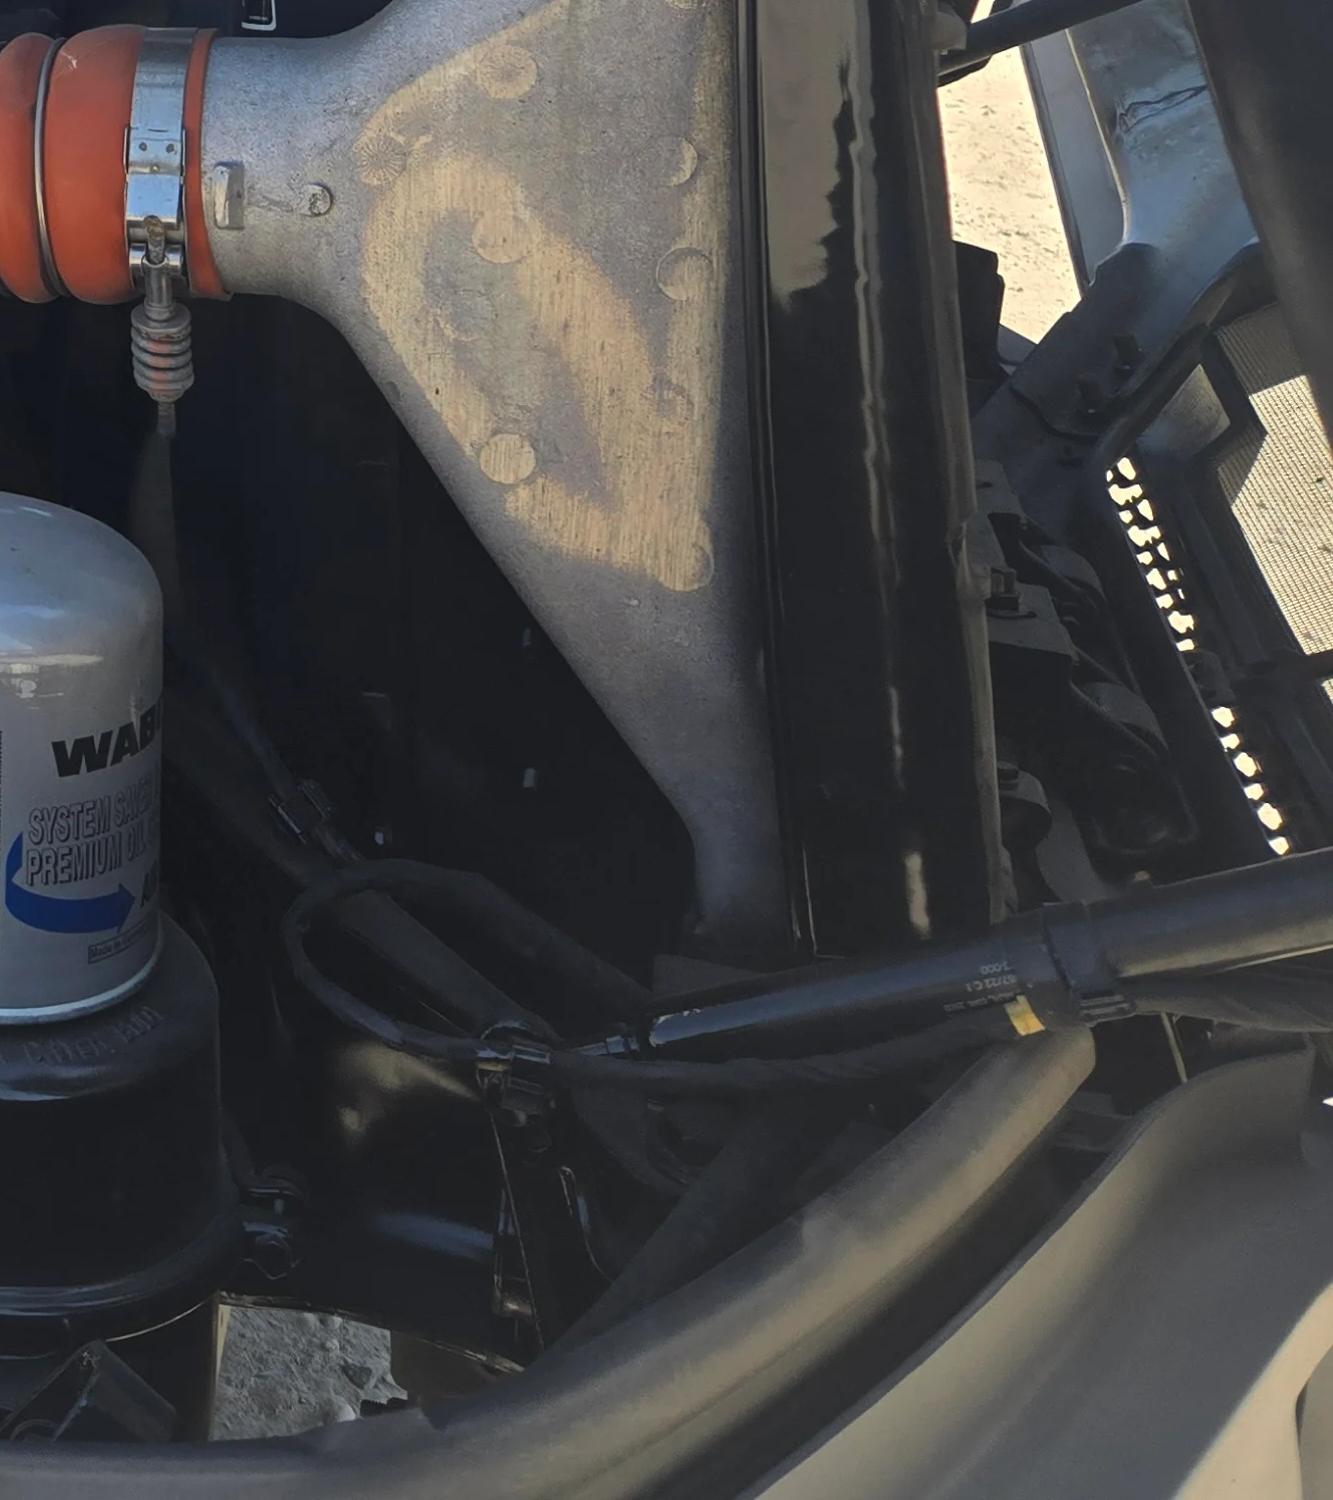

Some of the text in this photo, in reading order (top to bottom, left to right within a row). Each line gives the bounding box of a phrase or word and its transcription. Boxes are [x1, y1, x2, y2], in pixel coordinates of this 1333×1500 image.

[51, 702, 161, 777] WAB
[28, 793, 111, 846] SYSTEM
[25, 830, 123, 887] PREMIUM
